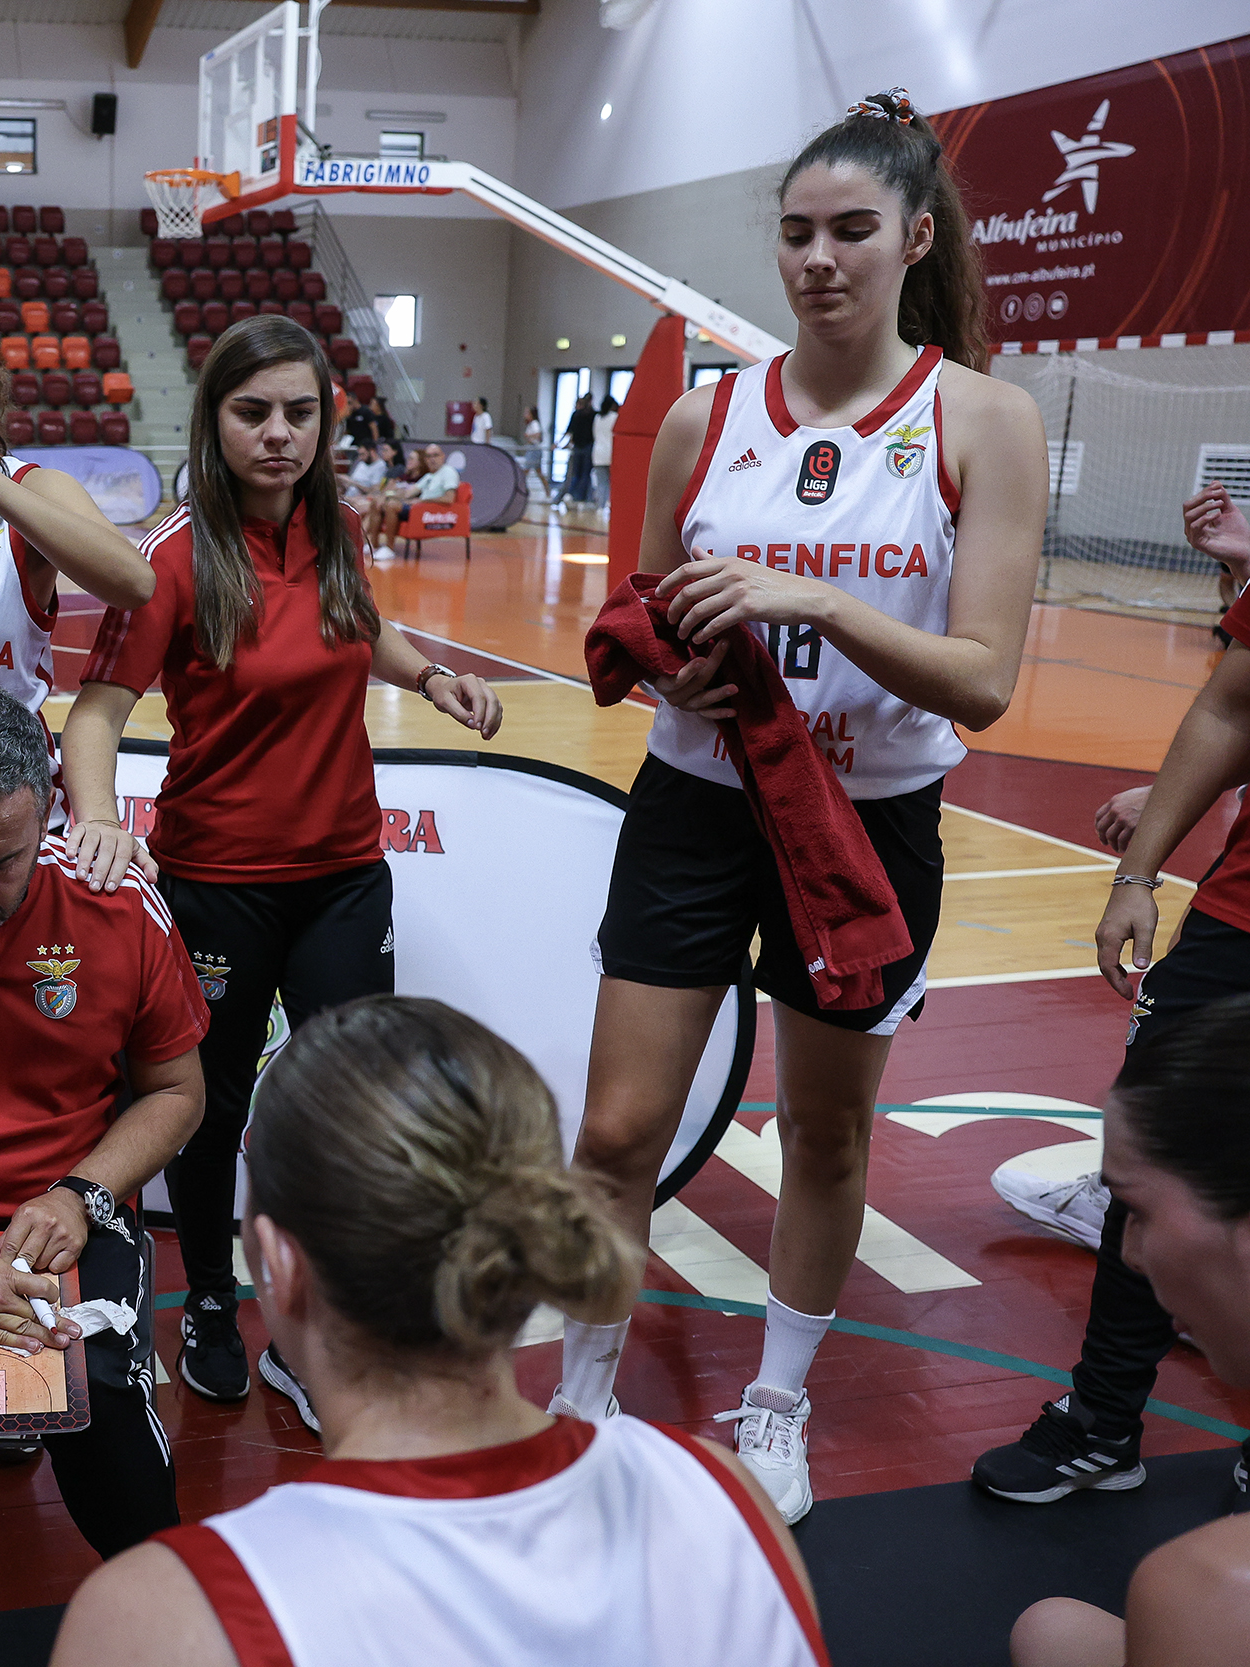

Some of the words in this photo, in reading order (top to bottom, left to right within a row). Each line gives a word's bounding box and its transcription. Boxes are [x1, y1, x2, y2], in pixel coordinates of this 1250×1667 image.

[305, 161, 430, 184] FABRIGIMNO
[970, 207, 1079, 246] Albufeira
[728, 460, 762, 472] adidas
